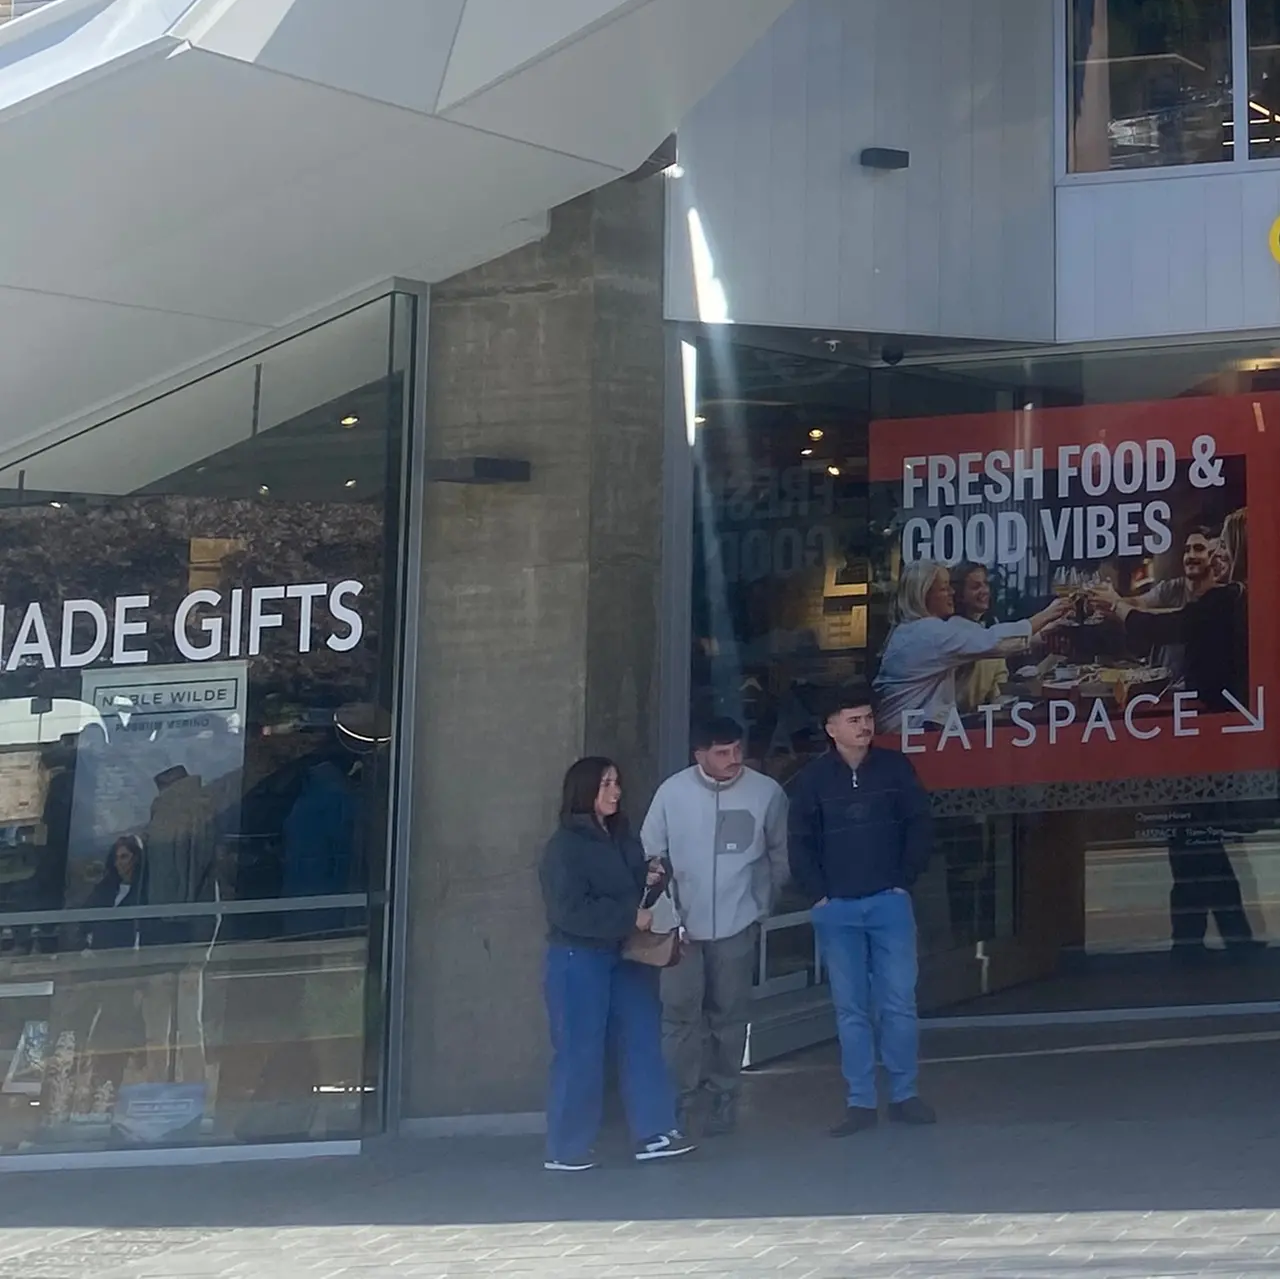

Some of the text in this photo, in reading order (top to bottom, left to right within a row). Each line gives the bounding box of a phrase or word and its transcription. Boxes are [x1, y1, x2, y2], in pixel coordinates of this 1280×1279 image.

[903, 434, 1225, 509] FRESH FOOD &
[902, 500, 1172, 568] GOOD VIBES
[0, 580, 365, 671] ADE GIFTS
[102, 688, 228, 707] NBLE WILDE
[901, 689, 1200, 754] EATSPACE
